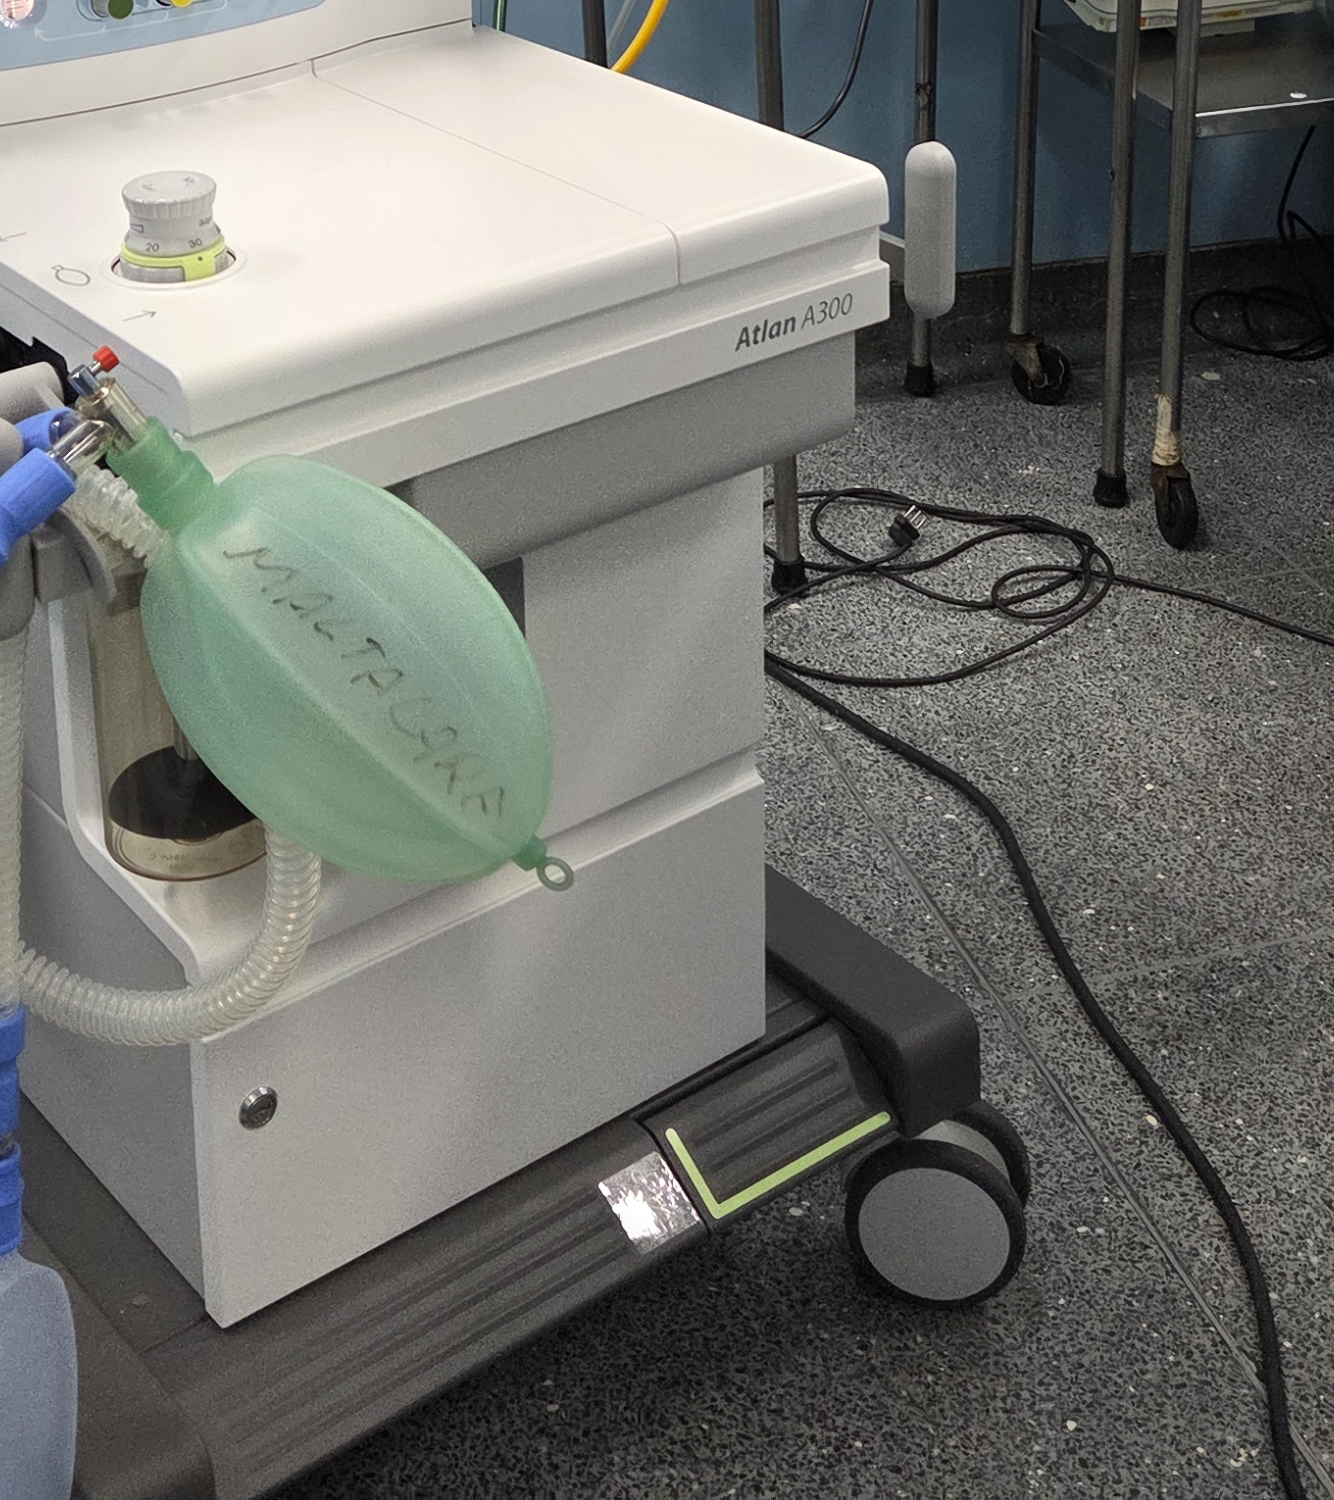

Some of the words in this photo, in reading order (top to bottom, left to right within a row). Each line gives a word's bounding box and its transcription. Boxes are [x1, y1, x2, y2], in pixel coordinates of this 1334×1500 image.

[145, 242, 160, 253] 20
[188, 237, 203, 249] 30
[734, 313, 798, 352] Atlan
[800, 291, 855, 331] A300
